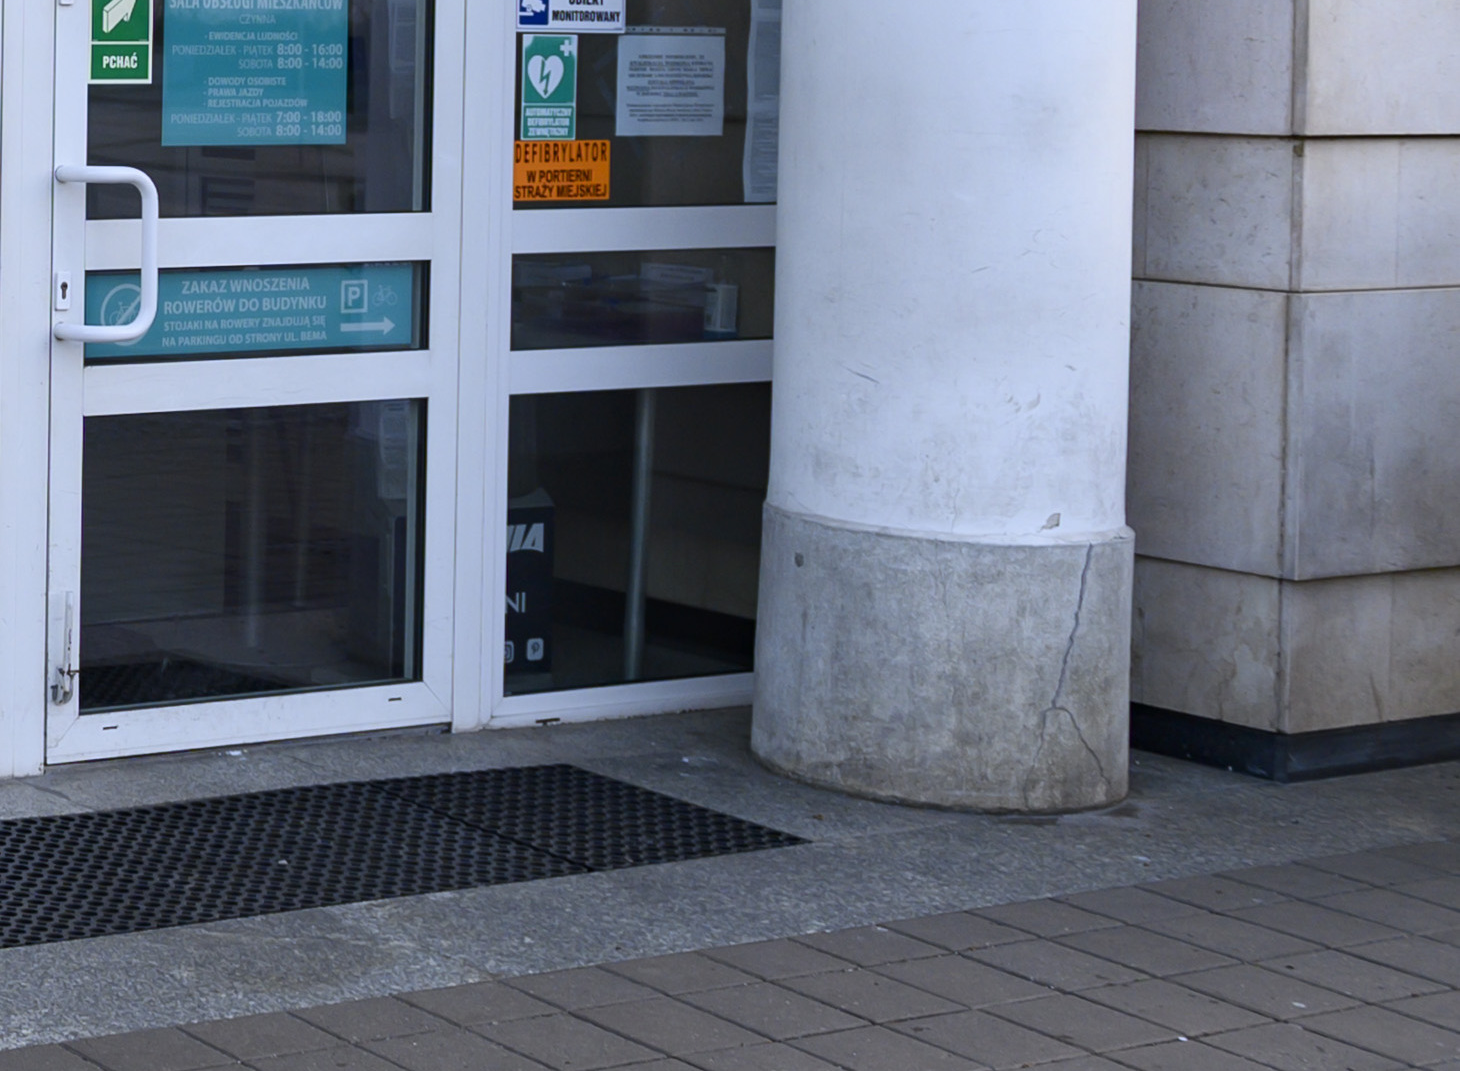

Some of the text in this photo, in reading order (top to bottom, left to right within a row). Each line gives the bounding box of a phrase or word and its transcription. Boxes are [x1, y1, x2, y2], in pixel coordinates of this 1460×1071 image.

[238, 14, 276, 25] CZYNNA
[552, 10, 621, 23] MONITOROWANY
[208, 31, 256, 41] EWIDENCJA
[172, 45, 237, 56] PONIEDZIAŁEK
[243, 45, 273, 58] PIĄTEK
[276, 43, 302, 56] 8:00
[312, 44, 343, 55] 16:00
[102, 52, 139, 70] PCHAĆ
[238, 58, 273, 69] SOBOTA
[277, 57, 302, 69] 8:00
[312, 57, 343, 69] 14:00
[208, 77, 245, 86] DOWODY
[207, 88, 264, 97] PRAWA JAZDY
[207, 99, 262, 108] REJESTRACJA
[171, 113, 235, 124] PONIEDZIAŁEK
[242, 113, 272, 126] PIĄTEK
[275, 111, 301, 123] 7:00
[311, 111, 342, 123] 18:00
[237, 127, 272, 138] SOBOTA
[275, 125, 301, 136] 8:00
[311, 125, 342, 136] 14:00
[515, 142, 607, 163] DEFIBRYLATOR
[526, 169, 593, 183] W PORTIERNI
[514, 182, 607, 199] STRAŻY MIEJSKIEJ
[181, 277, 310, 295] ZAKAZ WNOSZENIA
[163, 296, 327, 315] ROWERÓW DO BUDYNKU
[163, 315, 326, 332] STOJAKI NA ROWERY ZNAJDUJĄ SIĘ
[162, 330, 327, 347] NA PARKINGU OD STRONY UL. BEMA
